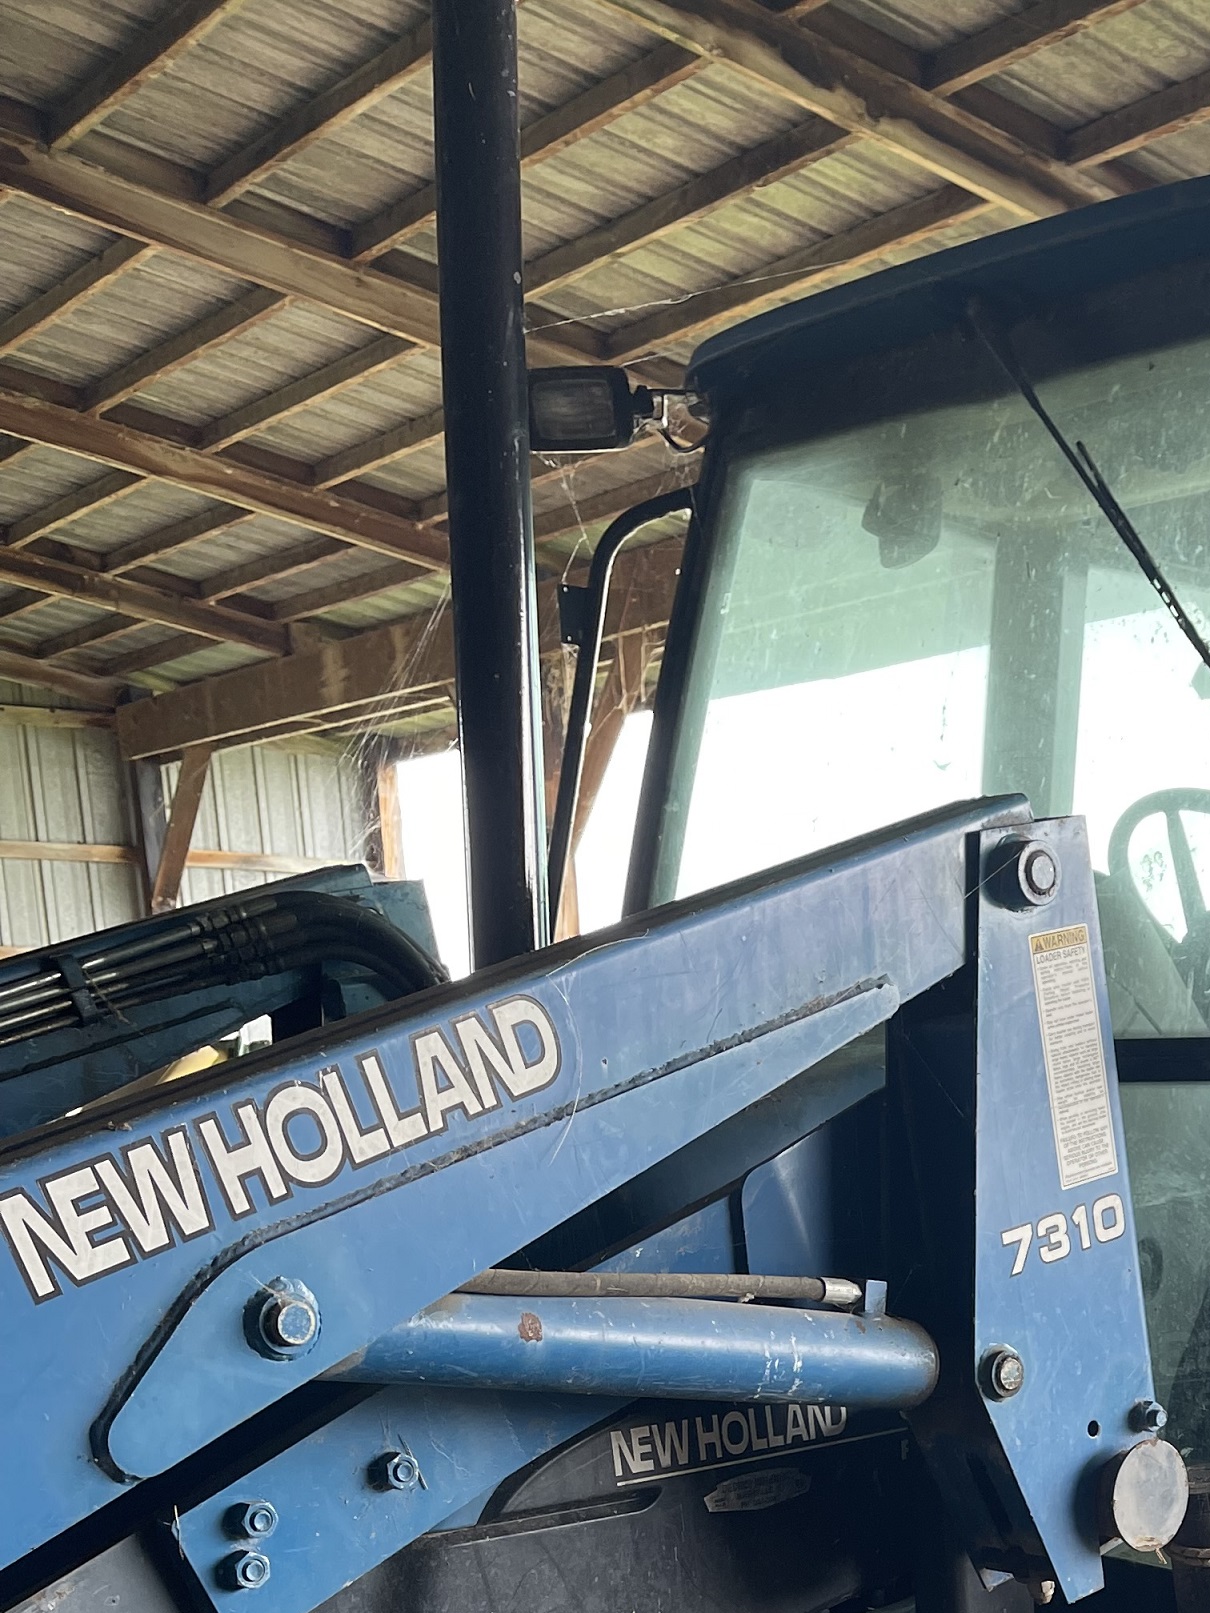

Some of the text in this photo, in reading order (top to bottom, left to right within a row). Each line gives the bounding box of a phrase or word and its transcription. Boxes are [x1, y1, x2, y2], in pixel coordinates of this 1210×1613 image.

[1035, 944, 1086, 966] LOADER SAFETY
[1041, 928, 1086, 950] WARNING
[0, 994, 560, 1304] NEW HOLLAND
[1001, 1192, 1126, 1278] 7310
[609, 1403, 848, 1477] NEW HOLLAND
